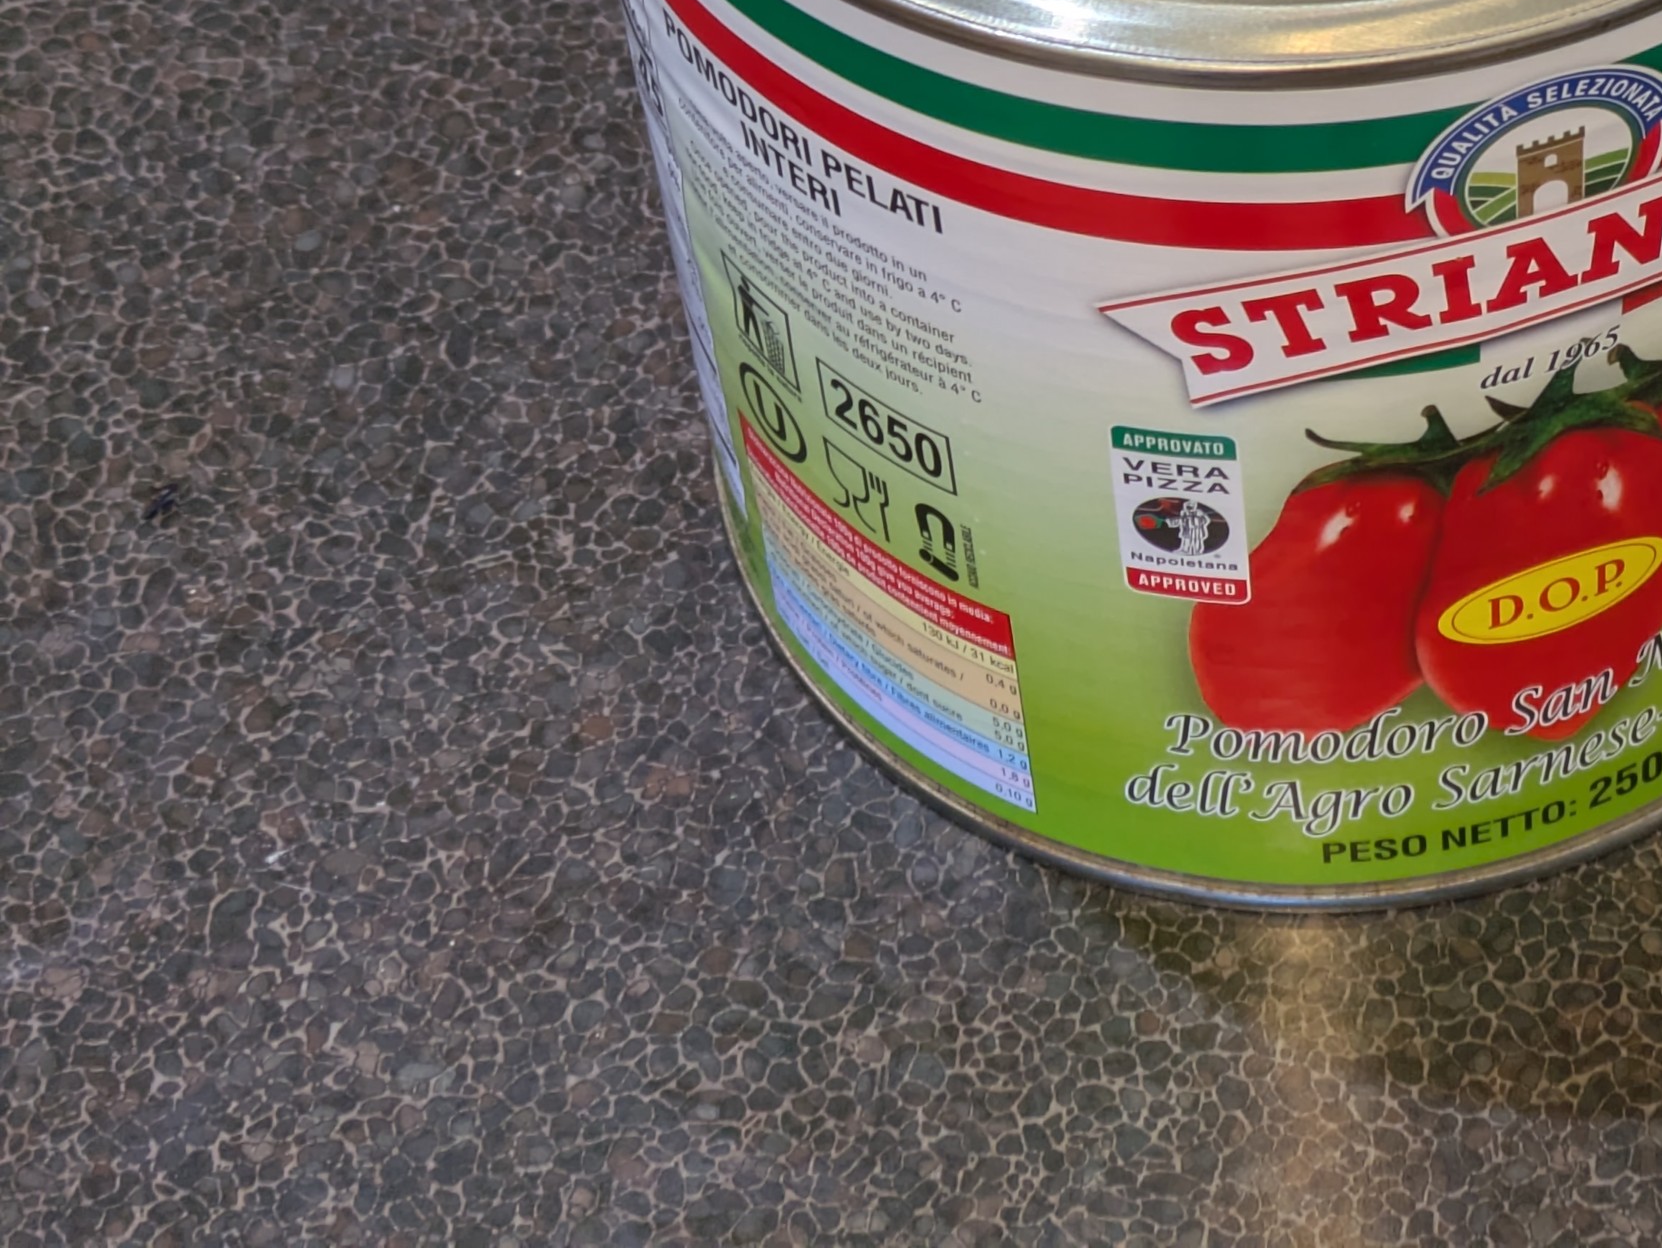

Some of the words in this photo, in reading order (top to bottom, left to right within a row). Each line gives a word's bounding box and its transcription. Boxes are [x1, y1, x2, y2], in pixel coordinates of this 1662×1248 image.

[663, 8, 812, 166] POMODORI
[820, 149, 944, 235] PELATI
[1431, 102, 1518, 180] QUALITÀ
[740, 120, 842, 217] INTERI
[795, 214, 863, 265] conservare
[866, 258, 878, 275] in
[881, 266, 914, 292] frigo
[918, 287, 926, 299] a
[951, 298, 962, 313] C
[826, 251, 848, 273] due
[852, 268, 893, 300] giorni.
[832, 224, 888, 263] prodotto
[892, 256, 904, 272] in
[909, 266, 928, 282] un
[802, 250, 848, 289] product
[851, 282, 875, 305] into
[879, 299, 887, 312] a
[890, 306, 955, 343] container
[811, 287, 853, 324] produit
[857, 318, 887, 345] dans
[891, 339, 908, 355] un
[912, 349, 973, 384] récipient
[834, 289, 856, 310] and
[860, 305, 883, 326] use
[886, 318, 902, 338] by
[905, 328, 931, 350] two
[935, 344, 973, 368] days.
[1480, 358, 1536, 391] dal
[1544, 324, 1621, 376] 1965
[832, 332, 849, 353] les
[852, 348, 882, 373] deux
[885, 366, 923, 395] jours.
[836, 322, 850, 338] au
[853, 332, 934, 383] réfrigérateur
[938, 376, 946, 390] à
[971, 389, 982, 404] C
[829, 377, 943, 479] 2650
[1122, 432, 1224, 456] APPROVATO
[1122, 456, 1231, 481] VERA
[1122, 472, 1231, 495] PIZZA
[1130, 551, 1238, 571] Napoletana
[1138, 573, 1237, 597] APPROVED
[1486, 557, 1627, 630] D.O.P.
[989, 655, 1014, 674] kcal
[1009, 684, 1018, 696] g
[924, 710, 990, 753] alimentaires
[1019, 759, 1028, 771] g
[1013, 710, 1021, 721] g
[1015, 728, 1024, 739] g
[1165, 705, 1488, 766] Pomodoro
[1512, 664, 1620, 736] San
[1017, 741, 1026, 752] g
[1022, 777, 1031, 789] g
[1025, 797, 1033, 808] g
[1322, 830, 1429, 865] PESO
[1440, 795, 1578, 853] NETTO:
